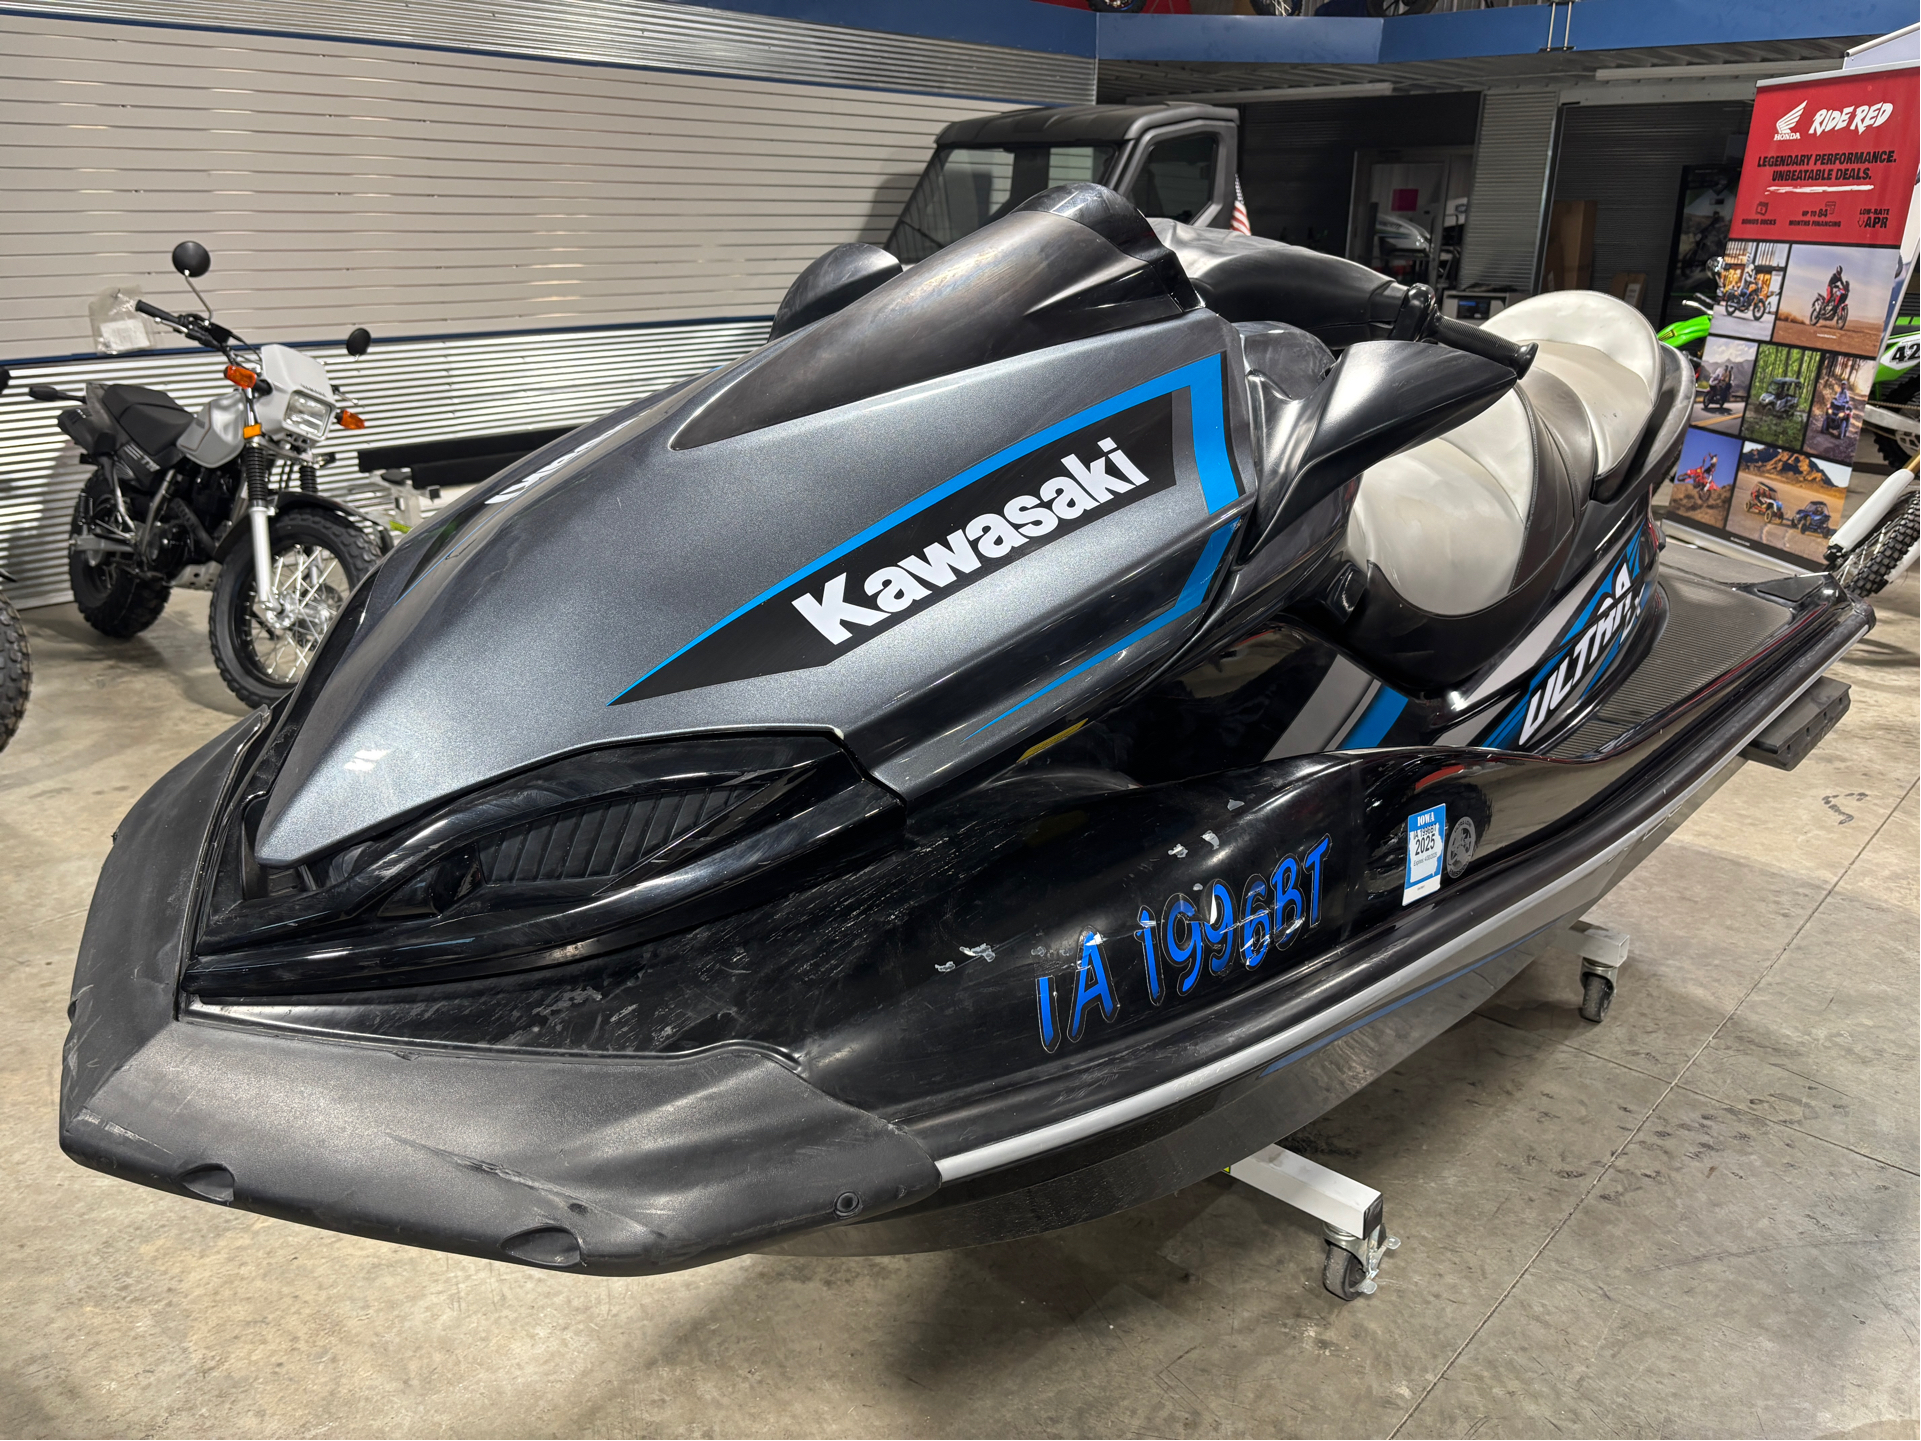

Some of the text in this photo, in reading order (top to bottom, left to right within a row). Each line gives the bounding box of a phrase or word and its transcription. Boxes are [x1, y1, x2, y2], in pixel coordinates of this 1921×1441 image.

[1808, 101, 1893, 136] RIDE RED
[1774, 132, 1800, 141] HONDA
[1757, 150, 1897, 167] LEGENDARY PERFORMANCE.
[1772, 168, 1872, 182] UNBEATABLE DEALS.
[1818, 208, 1828, 218] 84
[1859, 208, 1890, 216] LOW-RATE
[1811, 220, 1841, 228] FINANCING
[1864, 217, 1889, 228] APR
[791, 437, 1150, 645] Kawasaki
[1519, 562, 1632, 745] ULTRA
[1417, 812, 1435, 827] IOWA
[1415, 834, 1435, 856] 2025
[1036, 833, 1332, 1053] IA 1996BT
